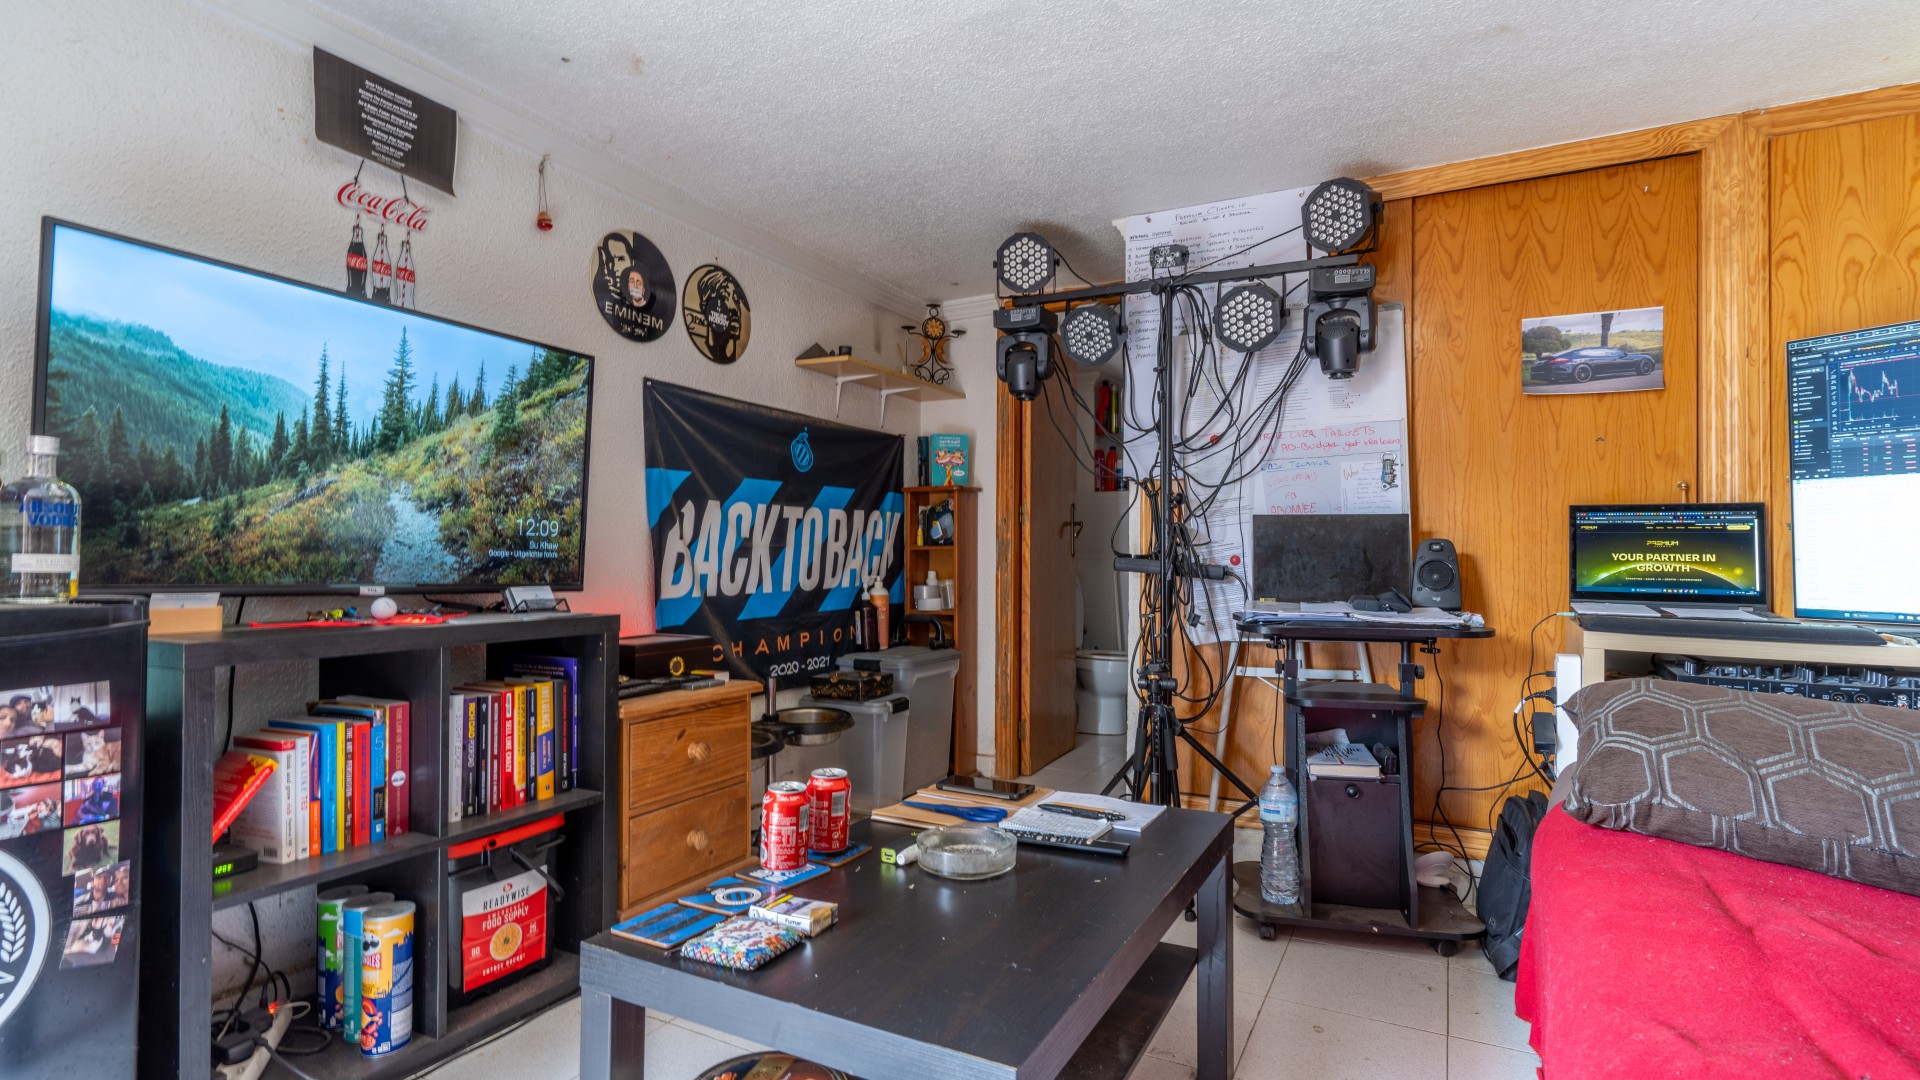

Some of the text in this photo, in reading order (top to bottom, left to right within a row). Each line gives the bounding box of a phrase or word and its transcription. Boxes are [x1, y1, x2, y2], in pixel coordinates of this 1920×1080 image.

[516, 518, 559, 538] 12:09
[488, 548, 510, 559] Google
[1611, 552, 1716, 562] YOUR PARTNER IN
[1636, 563, 1690, 572] GROWTH
[541, 685, 551, 730] INFLUENCE
[483, 886, 531, 911] READYWISE
[482, 905, 530, 932] FOOD SUPPLY
